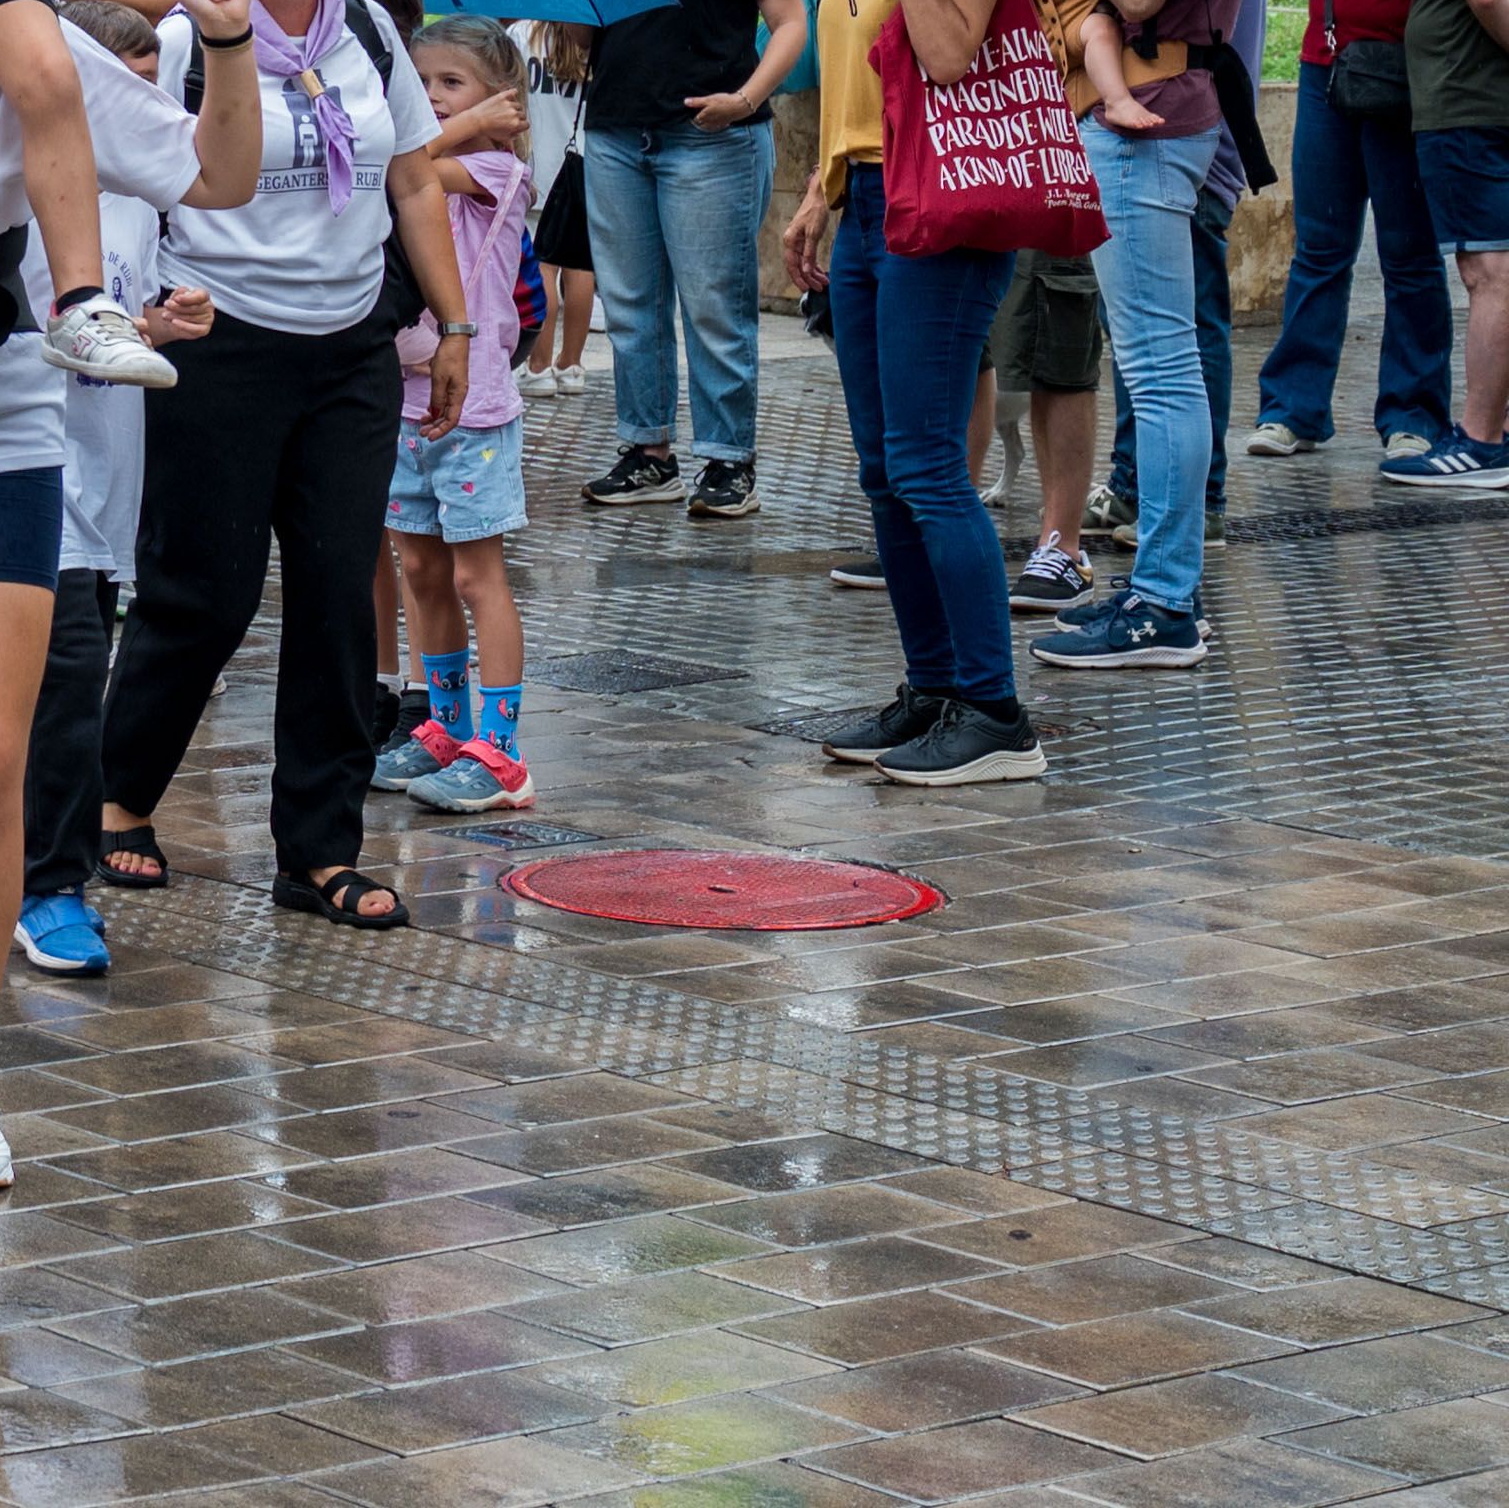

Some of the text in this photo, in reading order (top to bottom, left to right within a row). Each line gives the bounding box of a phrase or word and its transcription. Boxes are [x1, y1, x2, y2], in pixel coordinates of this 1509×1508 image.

[924, 68, 1040, 122] IMAGINED
[928, 110, 1037, 157] PARADISE
[1036, 106, 1074, 144] WILL
[940, 163, 957, 191] A
[953, 156, 1006, 190] KIND
[1007, 149, 1034, 189] OF
